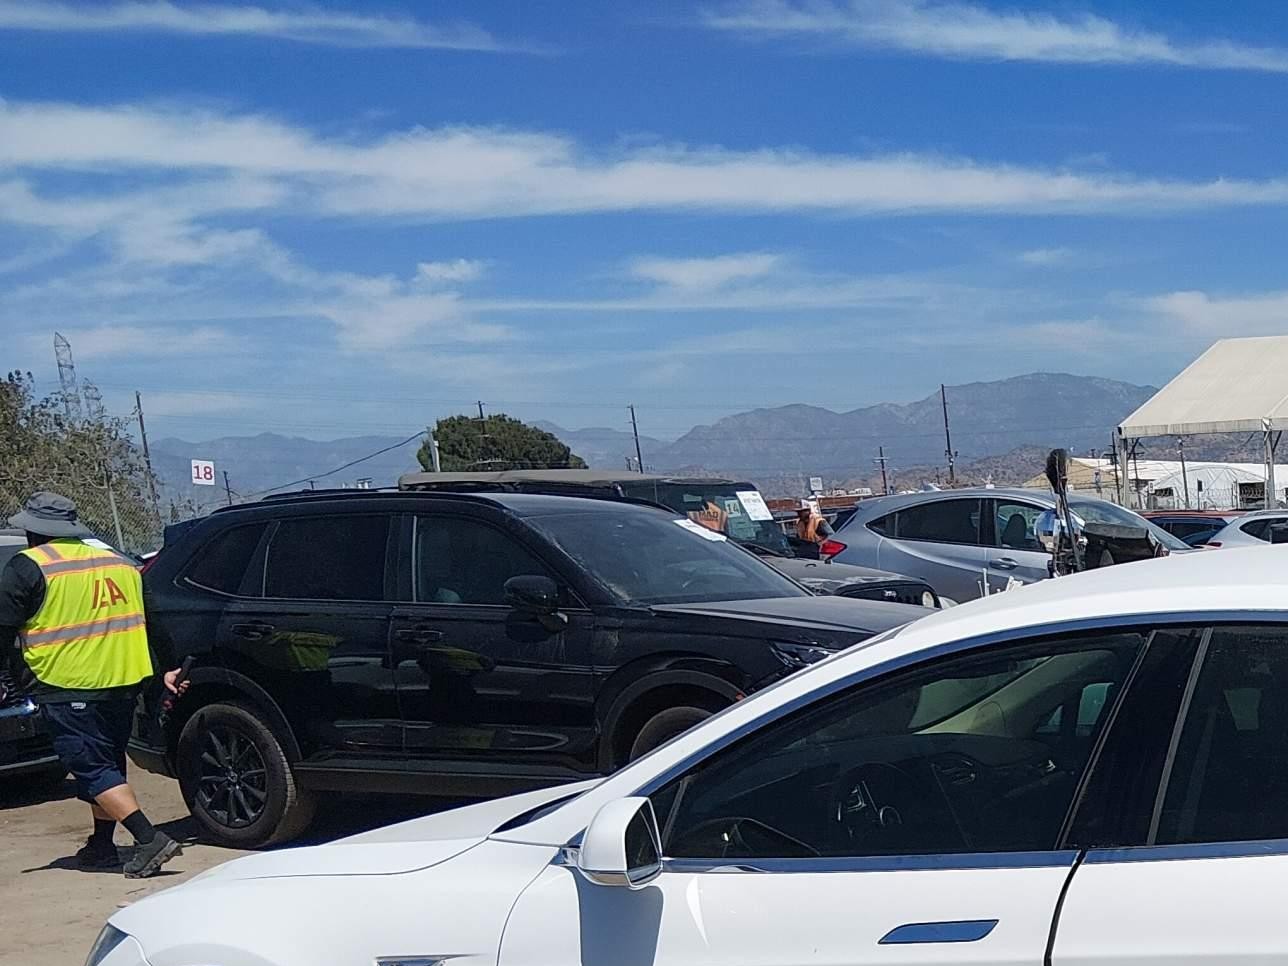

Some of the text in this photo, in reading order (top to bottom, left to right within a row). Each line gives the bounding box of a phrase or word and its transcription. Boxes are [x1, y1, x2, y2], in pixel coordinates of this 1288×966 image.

[193, 465, 213, 480] 18
[726, 503, 740, 515] 14
[91, 577, 128, 609] IA
